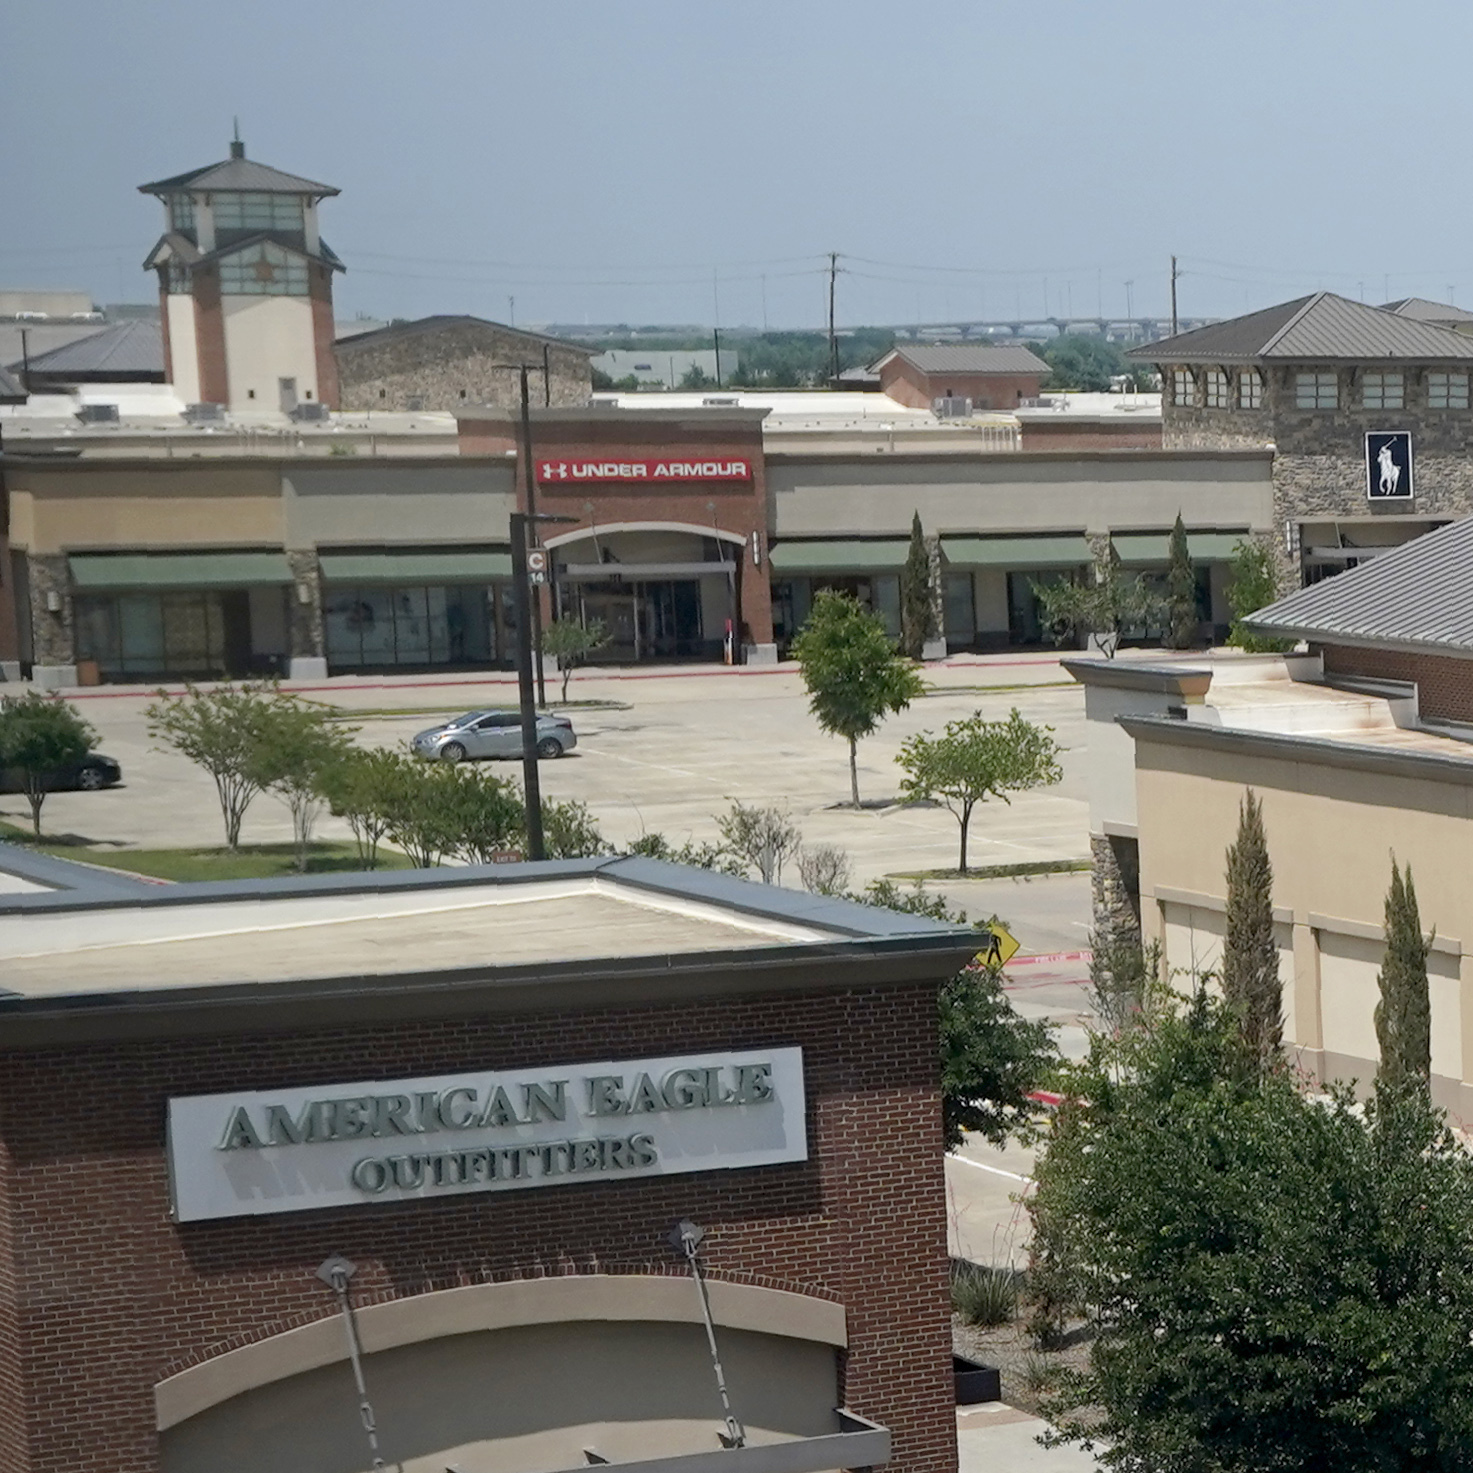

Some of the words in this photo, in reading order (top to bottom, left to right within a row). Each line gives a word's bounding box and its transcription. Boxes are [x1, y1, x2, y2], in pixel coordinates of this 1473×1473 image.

[572, 463, 647, 478] UNDER
[653, 462, 747, 477] ARMOUR
[528, 553, 544, 570] C
[530, 572, 545, 583] 14
[216, 1078, 570, 1152] AMERICAN
[584, 1062, 774, 1118] EAGLE
[350, 1132, 659, 1197] OUTFITTERS
